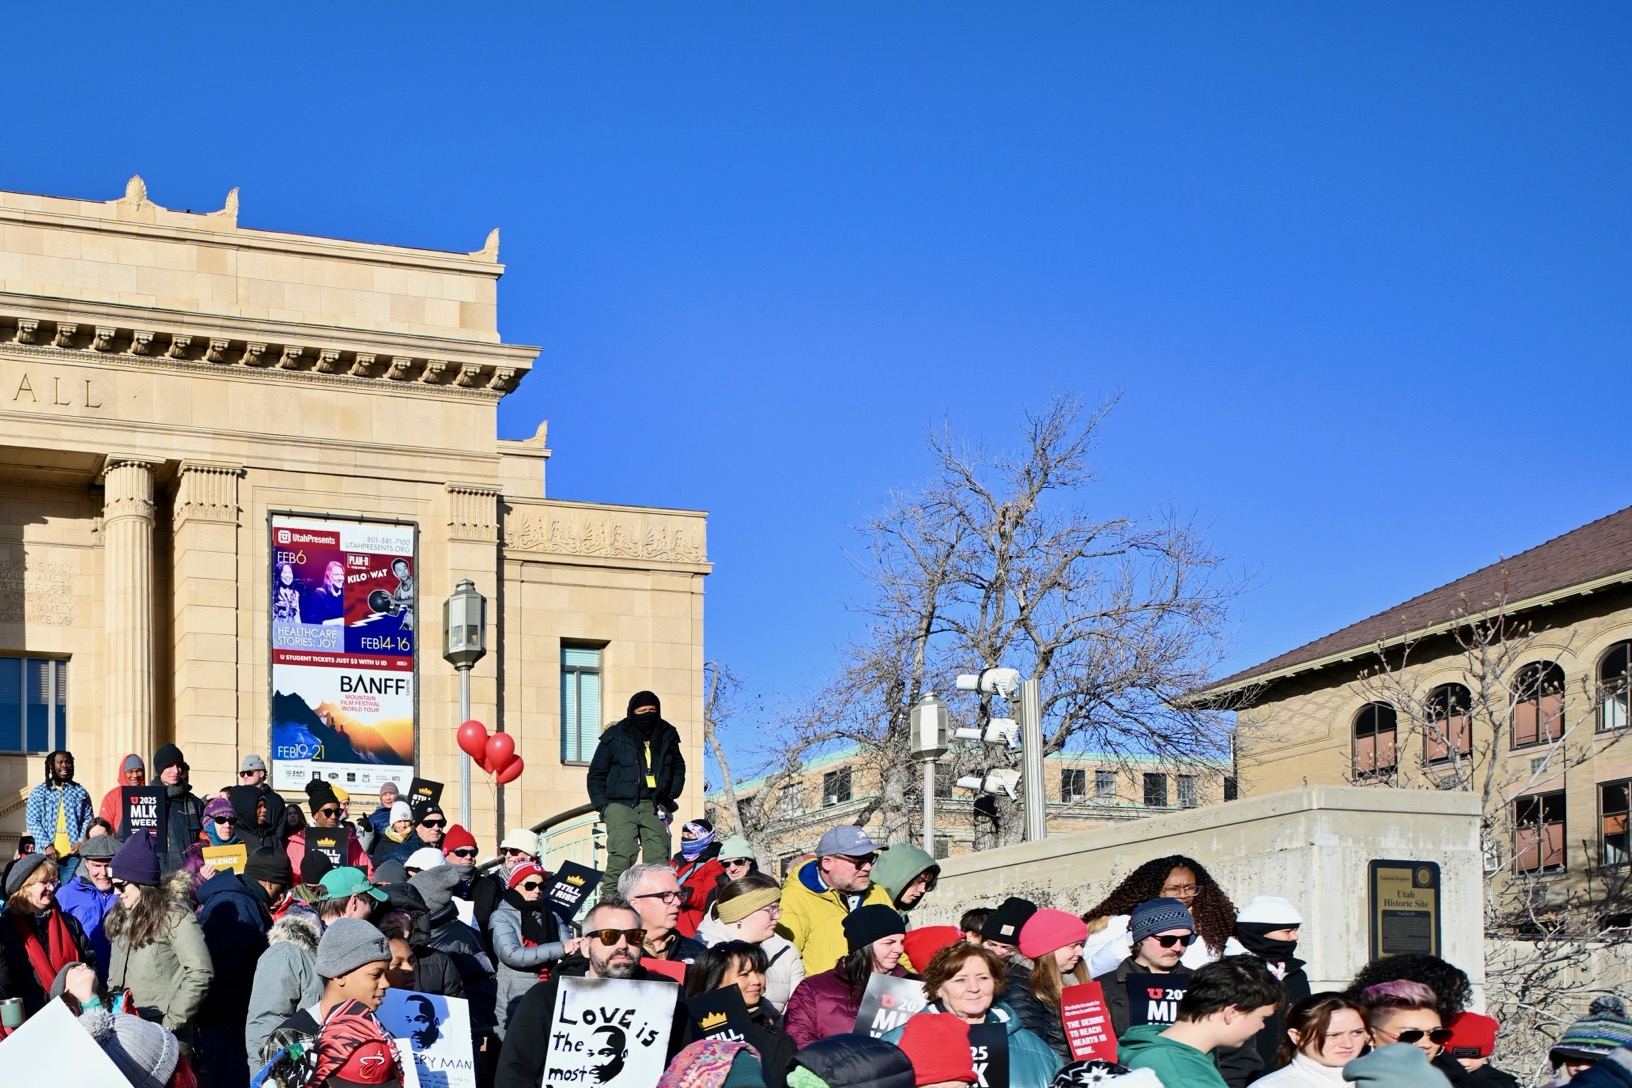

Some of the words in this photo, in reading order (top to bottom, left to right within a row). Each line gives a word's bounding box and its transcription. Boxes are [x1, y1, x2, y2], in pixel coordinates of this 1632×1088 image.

[292, 533, 336, 544] UtahPresents
[367, 536, 410, 545] 801-581-7100
[345, 542, 410, 553] UTAHPRESENTS.ORG
[277, 627, 337, 639] HEALTHCARE
[277, 636, 316, 647] STORIES:
[318, 638, 337, 648] JOY
[340, 674, 405, 696] BANFF
[130, 805, 157, 818] MLK
[131, 818, 157, 827] WEEK
[556, 891, 579, 904] RISE
[1397, 890, 1415, 898] Utah
[1383, 899, 1413, 907] Historic
[1415, 899, 1428, 908] Site
[553, 1031, 584, 1052] the
[548, 1066, 587, 1082] most
